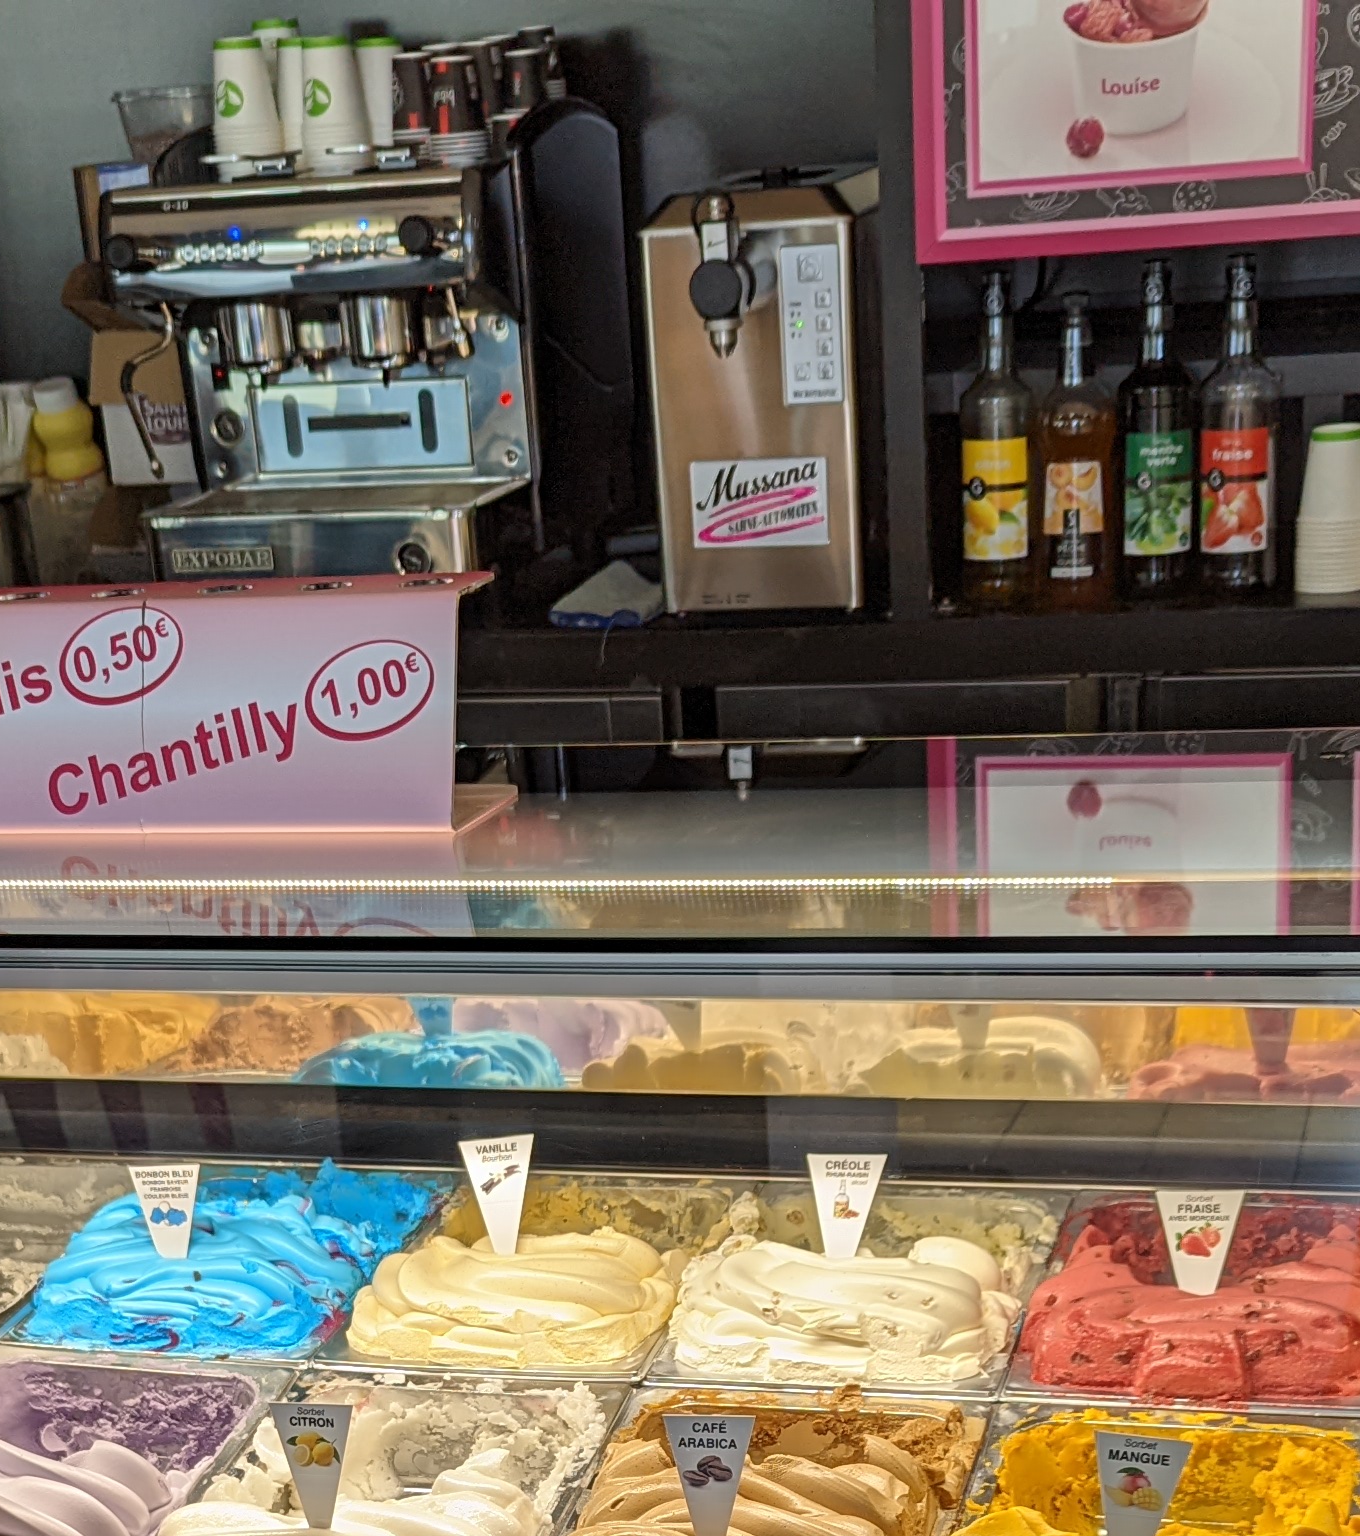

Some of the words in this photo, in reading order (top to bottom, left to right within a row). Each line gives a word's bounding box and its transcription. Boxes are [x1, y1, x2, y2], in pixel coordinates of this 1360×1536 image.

[1101, 77, 1161, 95] Louise
[696, 461, 819, 512] Mussana
[73, 616, 170, 686] 0,50€
[47, 701, 299, 815] Chantilly
[320, 651, 421, 720] 1,00€
[475, 1142, 518, 1154] VANILLE
[825, 1158, 871, 1171] CRÉOLE
[135, 1170, 170, 1179] BONBON
[172, 1170, 194, 1178] BLEU
[1177, 1203, 1221, 1214] FRAISE
[296, 1406, 326, 1416] Sorbet
[289, 1416, 335, 1428] CITRON
[692, 1420, 728, 1434] CAFÉ
[678, 1437, 738, 1449] ARABICA
[1124, 1438, 1159, 1450] Sorbet
[1108, 1448, 1171, 1467] MANGUE
